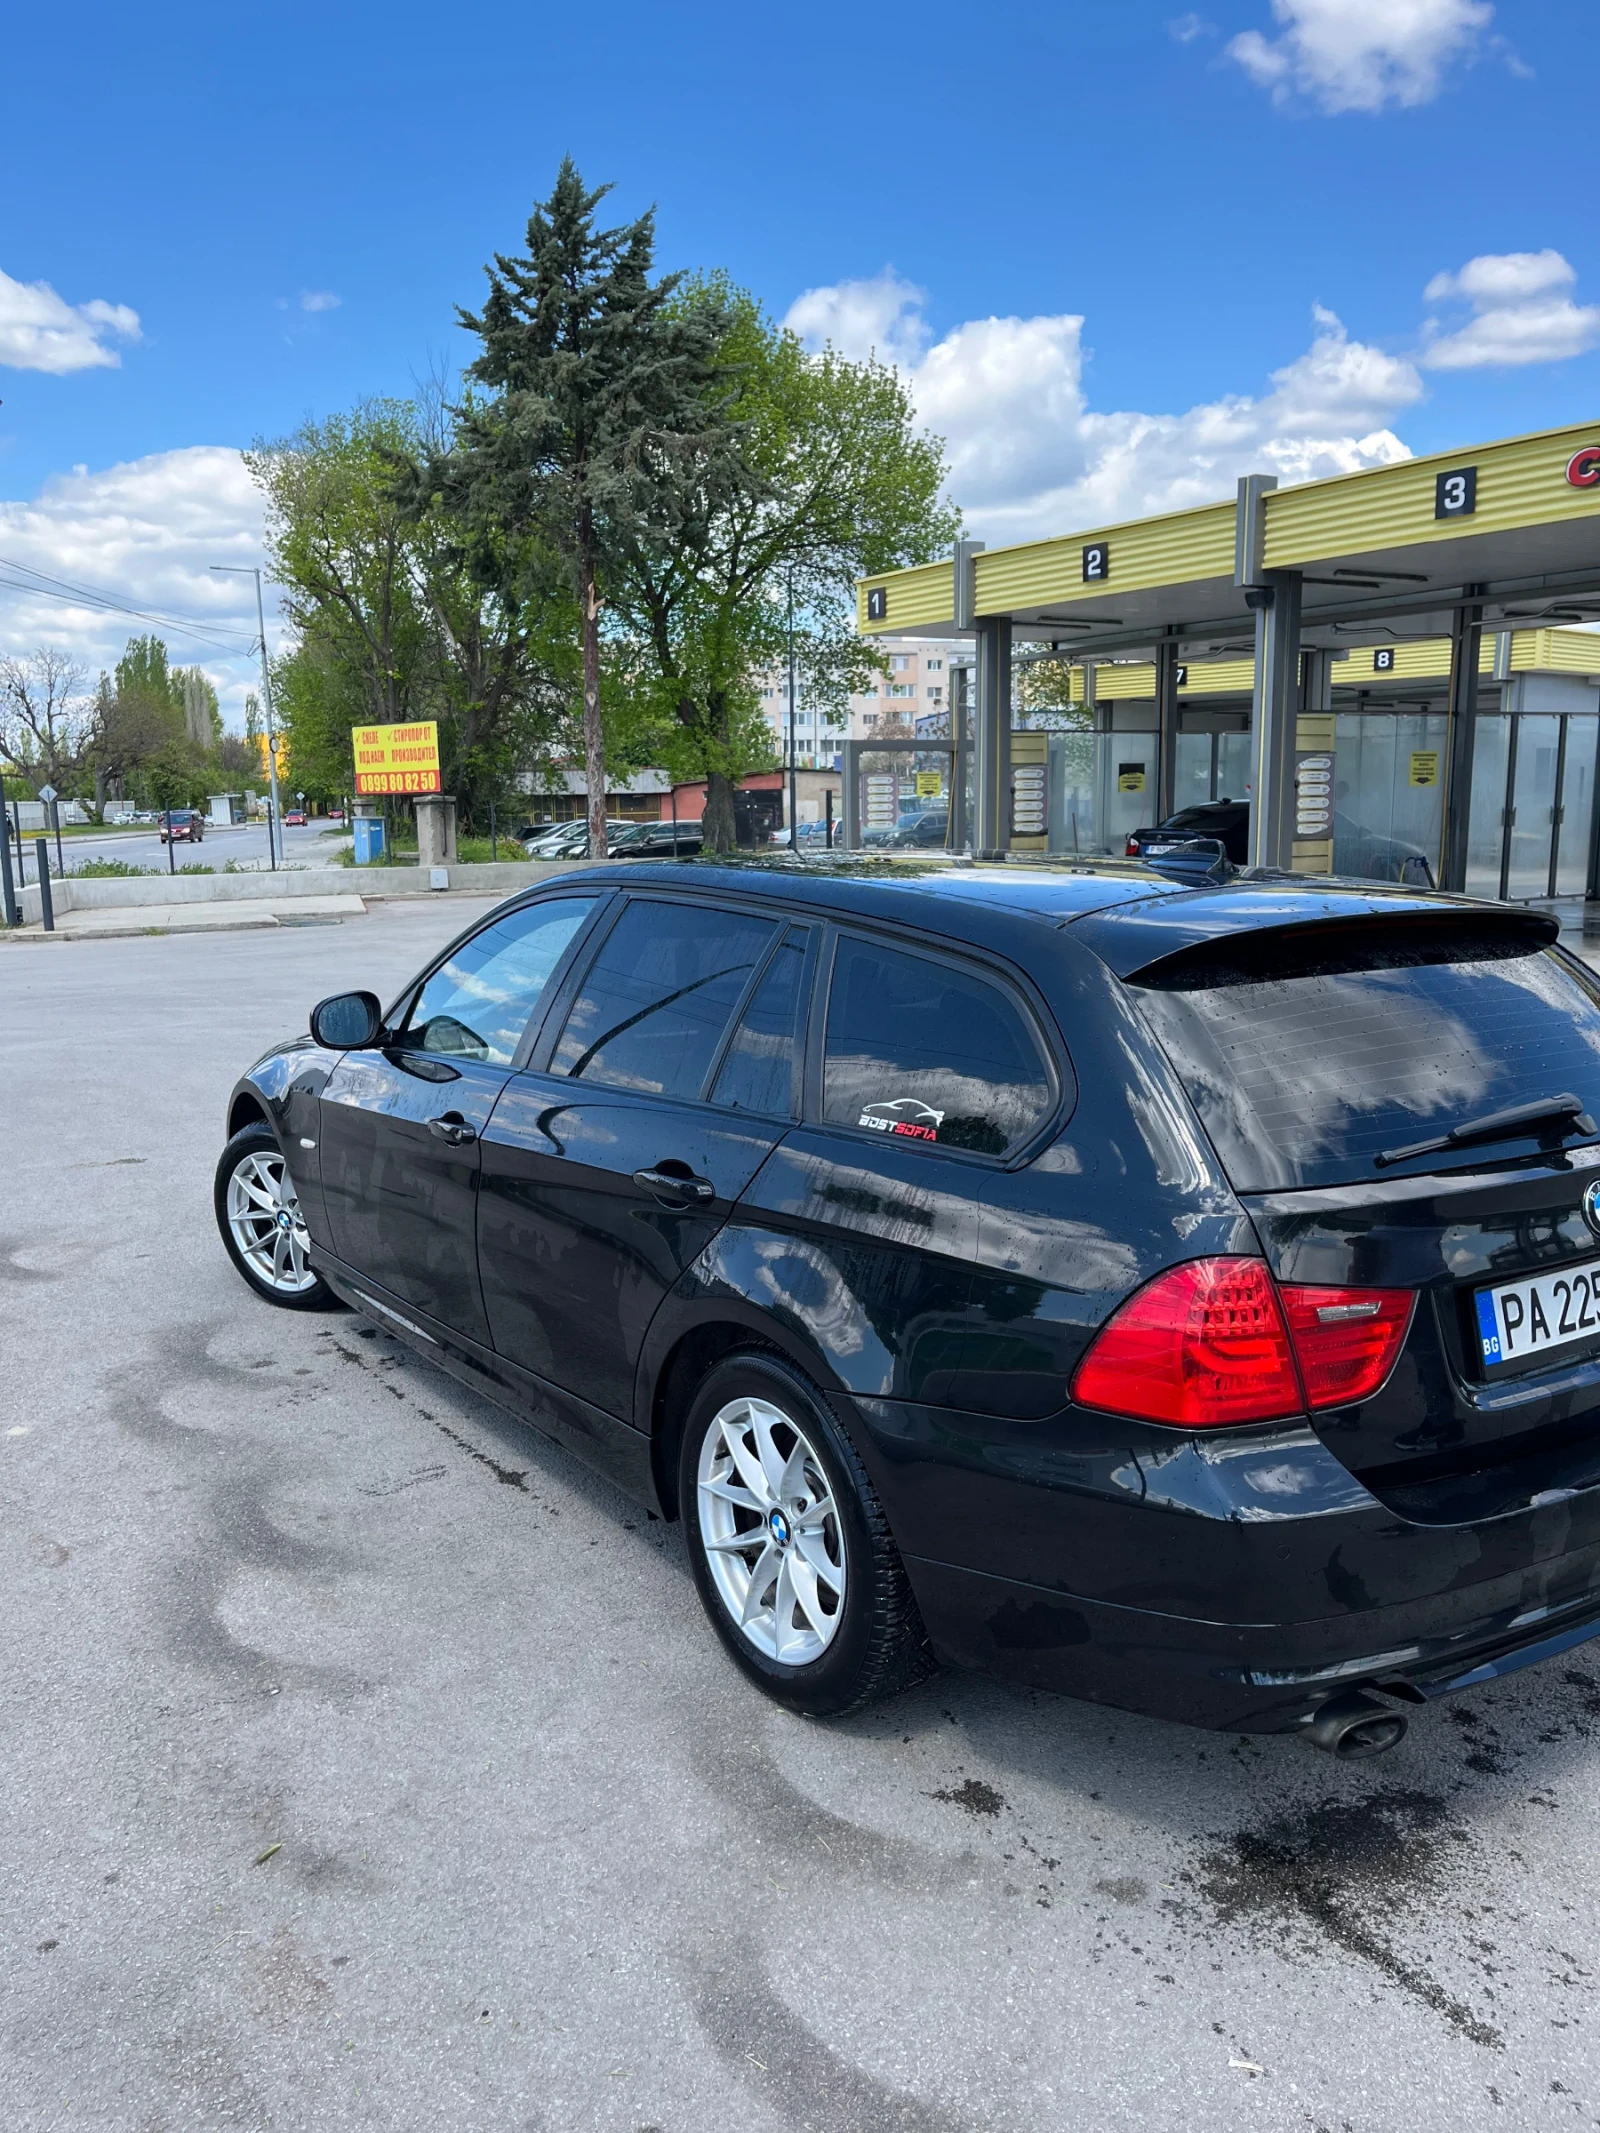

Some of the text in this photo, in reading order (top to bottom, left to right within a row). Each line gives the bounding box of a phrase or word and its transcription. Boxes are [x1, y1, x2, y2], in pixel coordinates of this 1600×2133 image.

[1444, 476, 1466, 510] 3
[1087, 549, 1101, 576] 2
[871, 593, 880, 614] 1
[1377, 651, 1390, 668] 8
[394, 726, 430, 742] СТИРОПОР ОТ
[359, 750, 384, 765] ПОД НАЕМ
[392, 746, 436, 762] ПРОИЗВОДИТЕЛ
[360, 771, 436, 792] 0899 80 82 50
[1501, 1287, 1550, 1350] PA
[1483, 1337, 1499, 1355] BG
